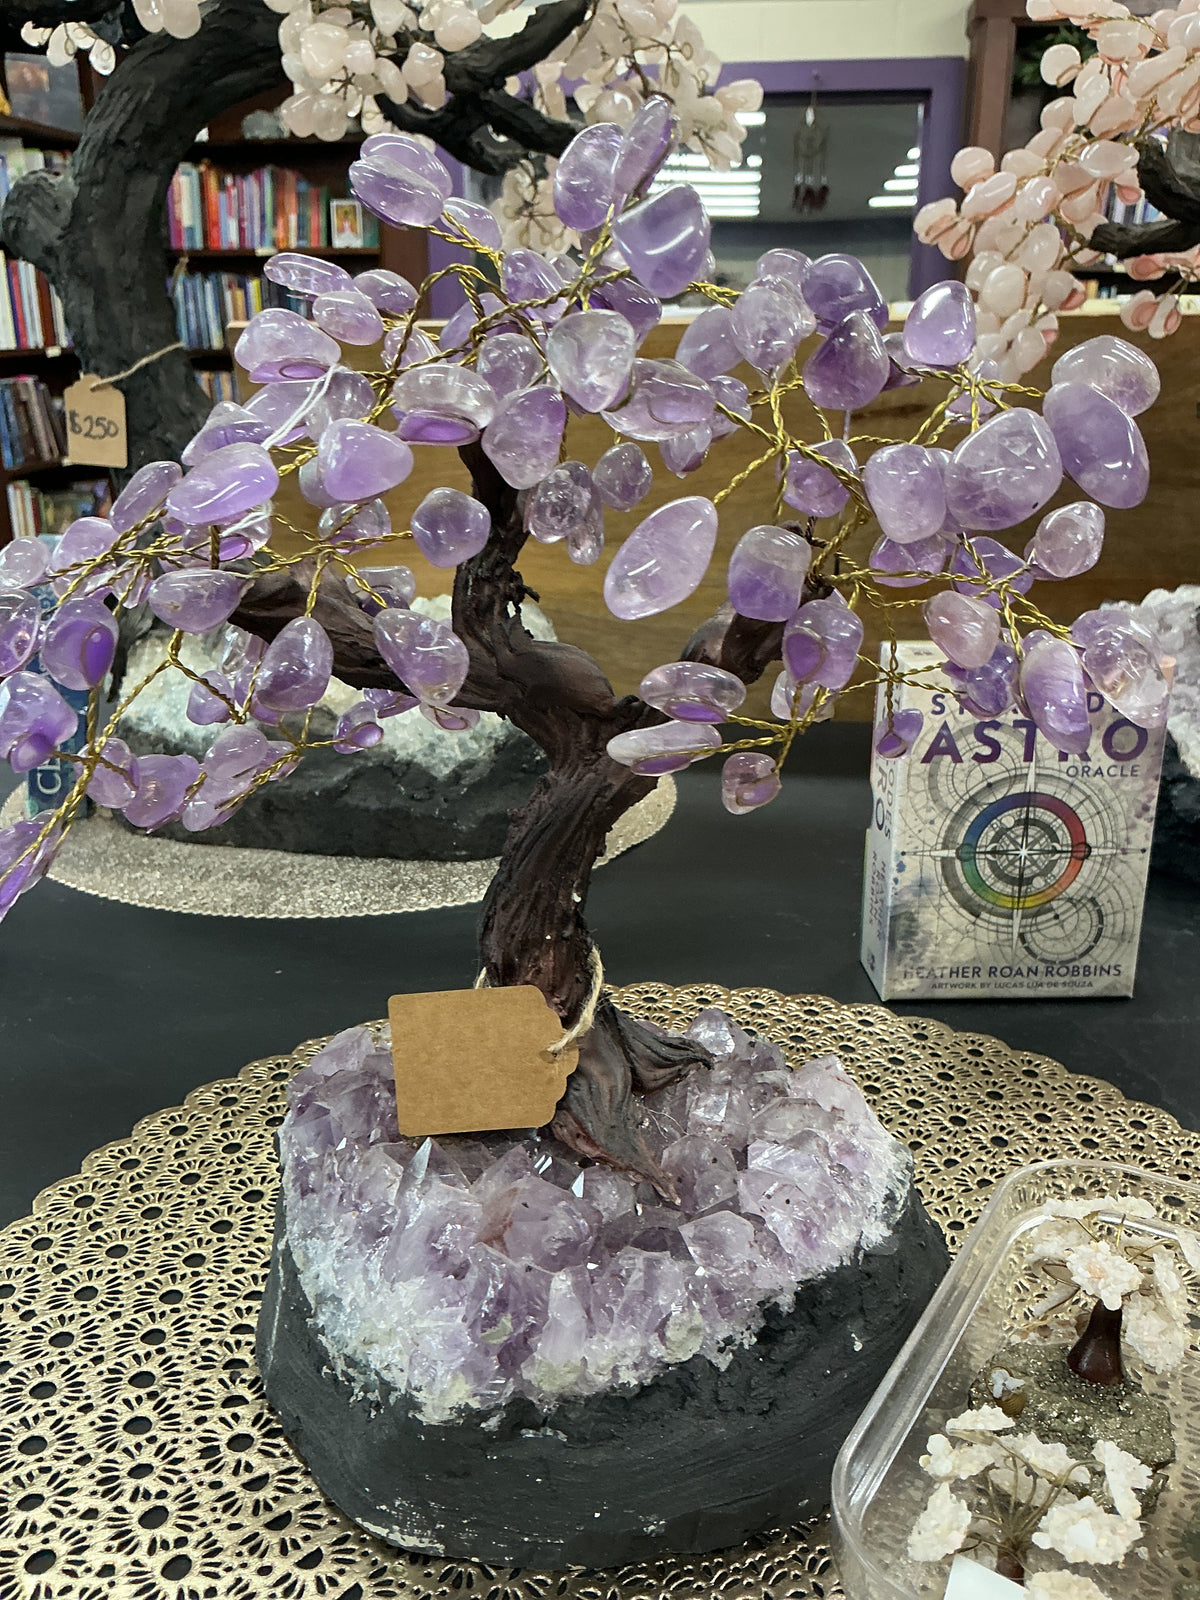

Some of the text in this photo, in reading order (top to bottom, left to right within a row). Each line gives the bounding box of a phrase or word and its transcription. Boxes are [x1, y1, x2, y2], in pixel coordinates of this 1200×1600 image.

[69, 409, 119, 439] $250
[920, 718, 1148, 764] ASTO
[1066, 764, 1140, 778] ORACLE
[903, 964, 1122, 979] HEATHER ROAN ROBBINS
[994, 981, 1024, 989] LUCAS
